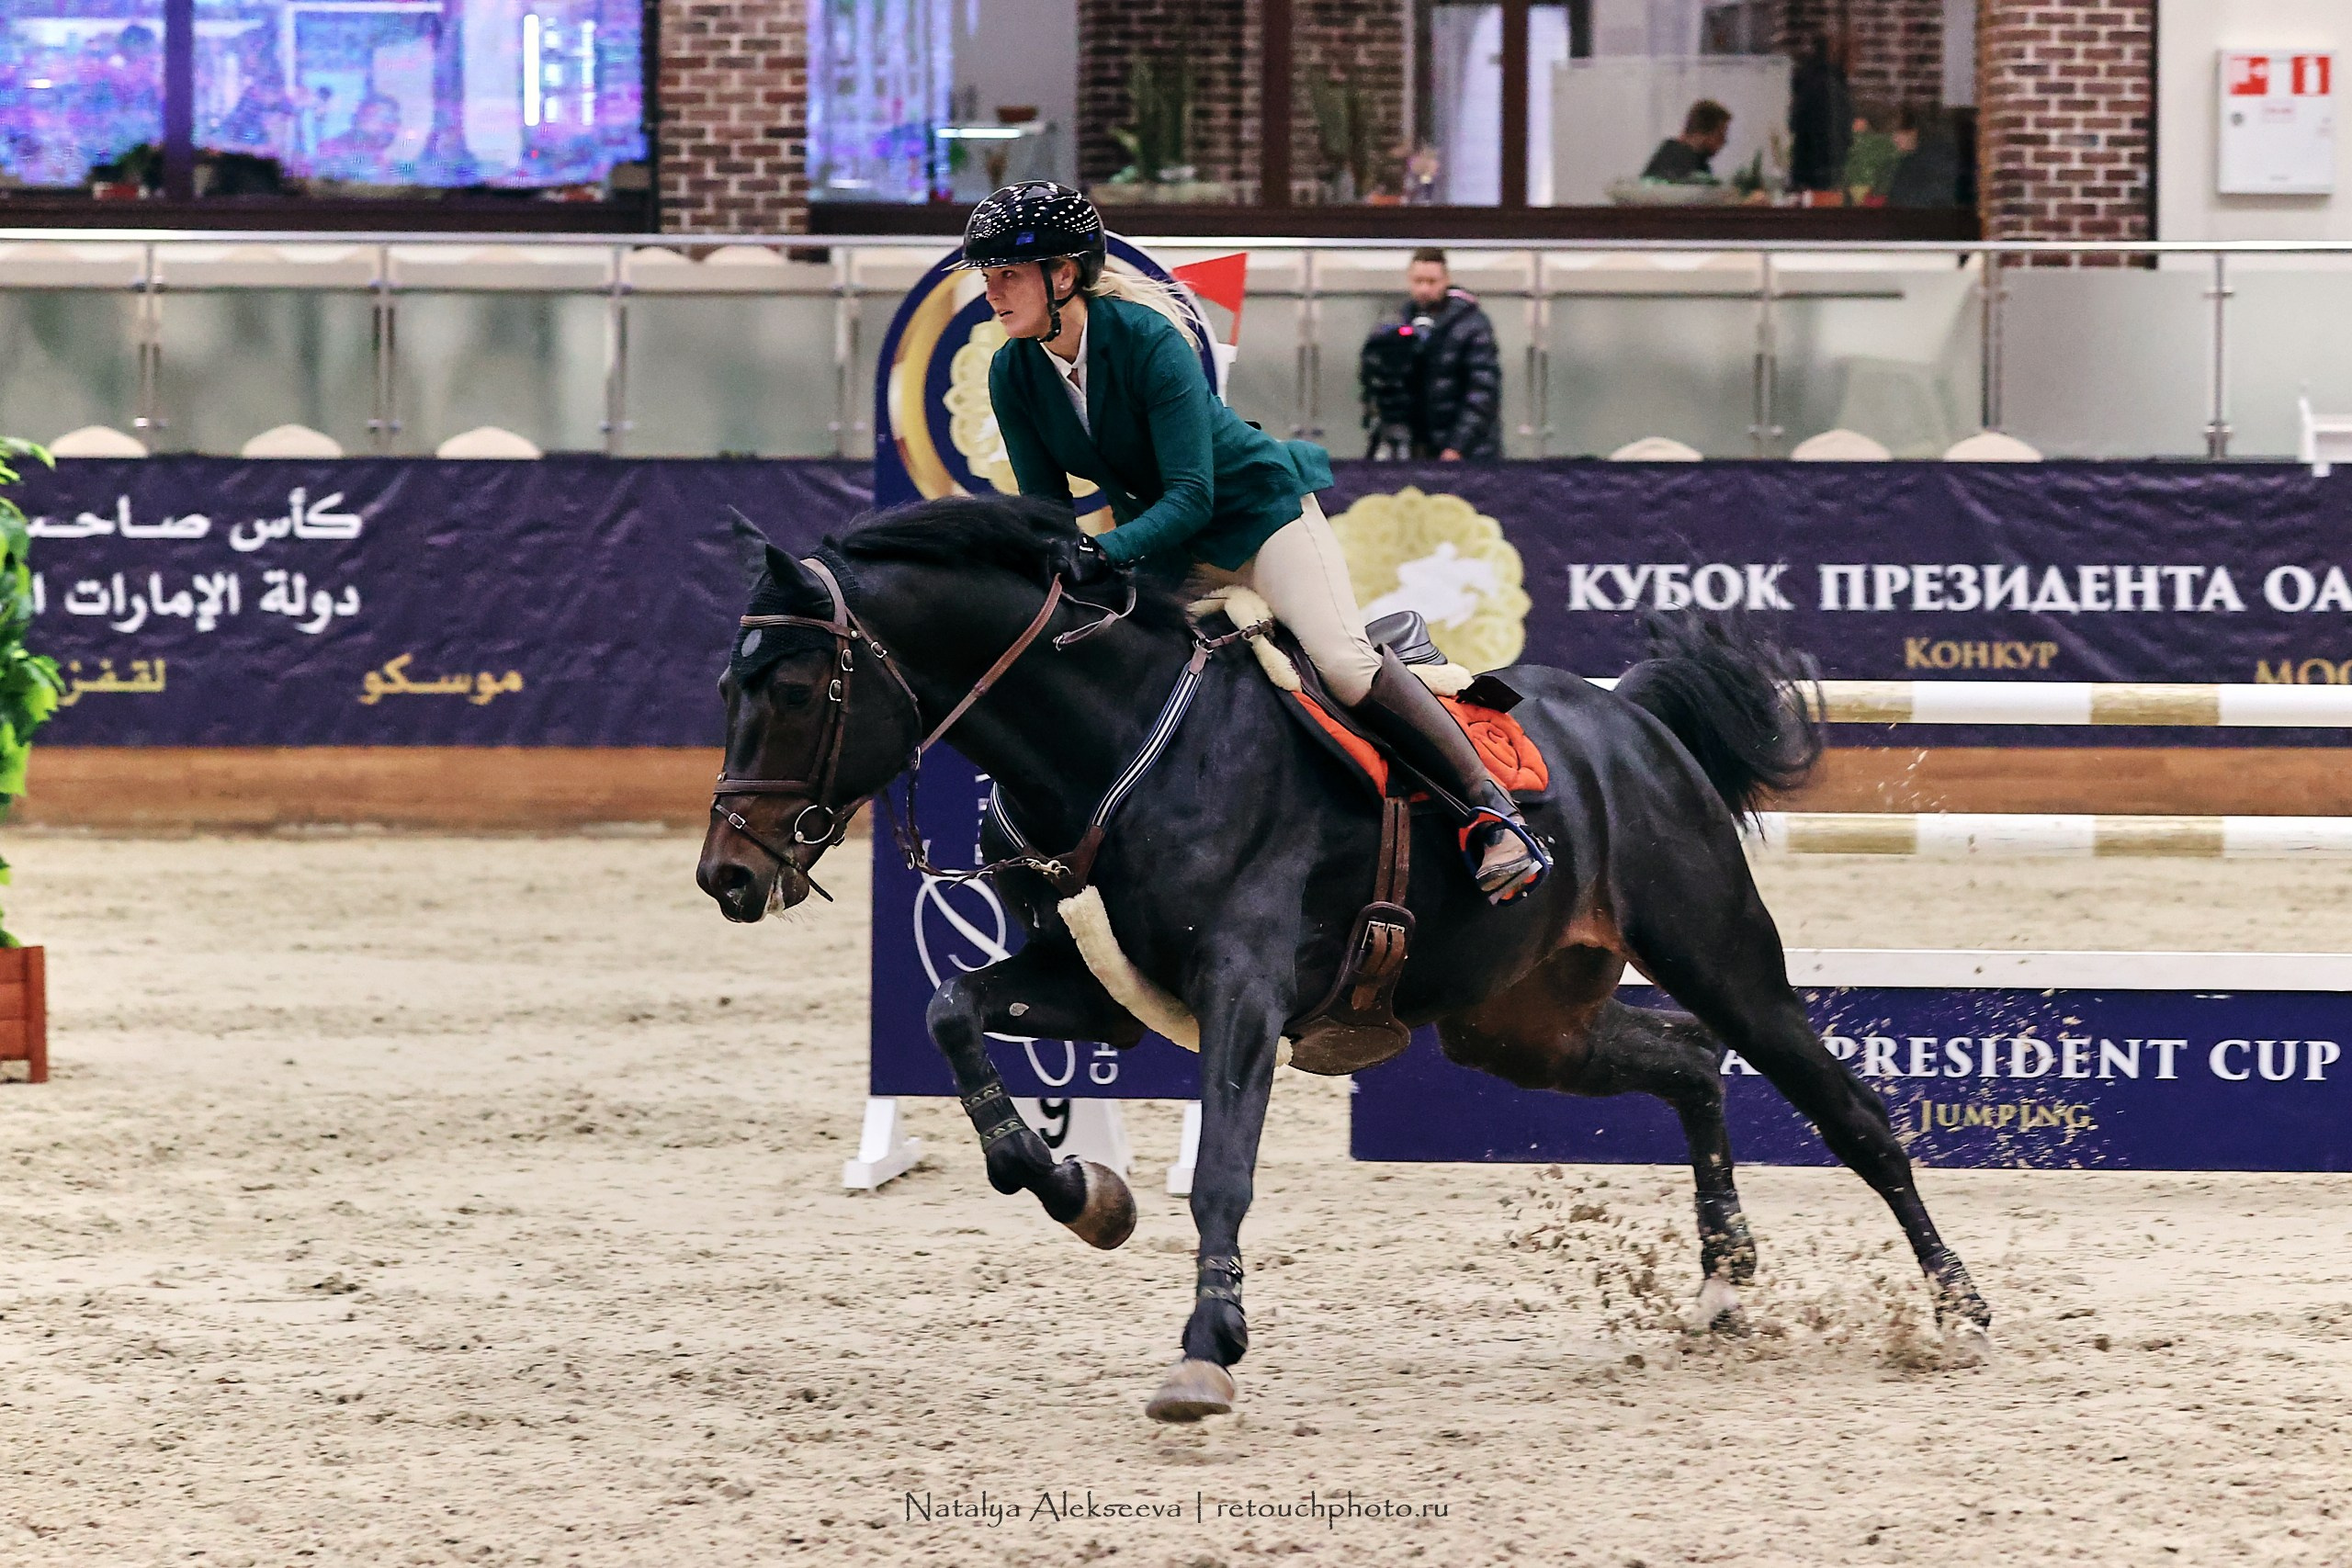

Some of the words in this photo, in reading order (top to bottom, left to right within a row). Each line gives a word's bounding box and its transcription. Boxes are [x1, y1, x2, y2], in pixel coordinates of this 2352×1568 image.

[27, 494, 211, 538] صاح
[229, 487, 363, 551] كأس
[63, 570, 241, 634] الإمارات
[258, 569, 362, 634] دولة
[1567, 563, 1794, 612] КУБОК
[1819, 563, 2247, 613] ПРЕЗИДЕНТА
[357, 652, 524, 705] موسكو
[2208, 1039, 2342, 1082] CUP
